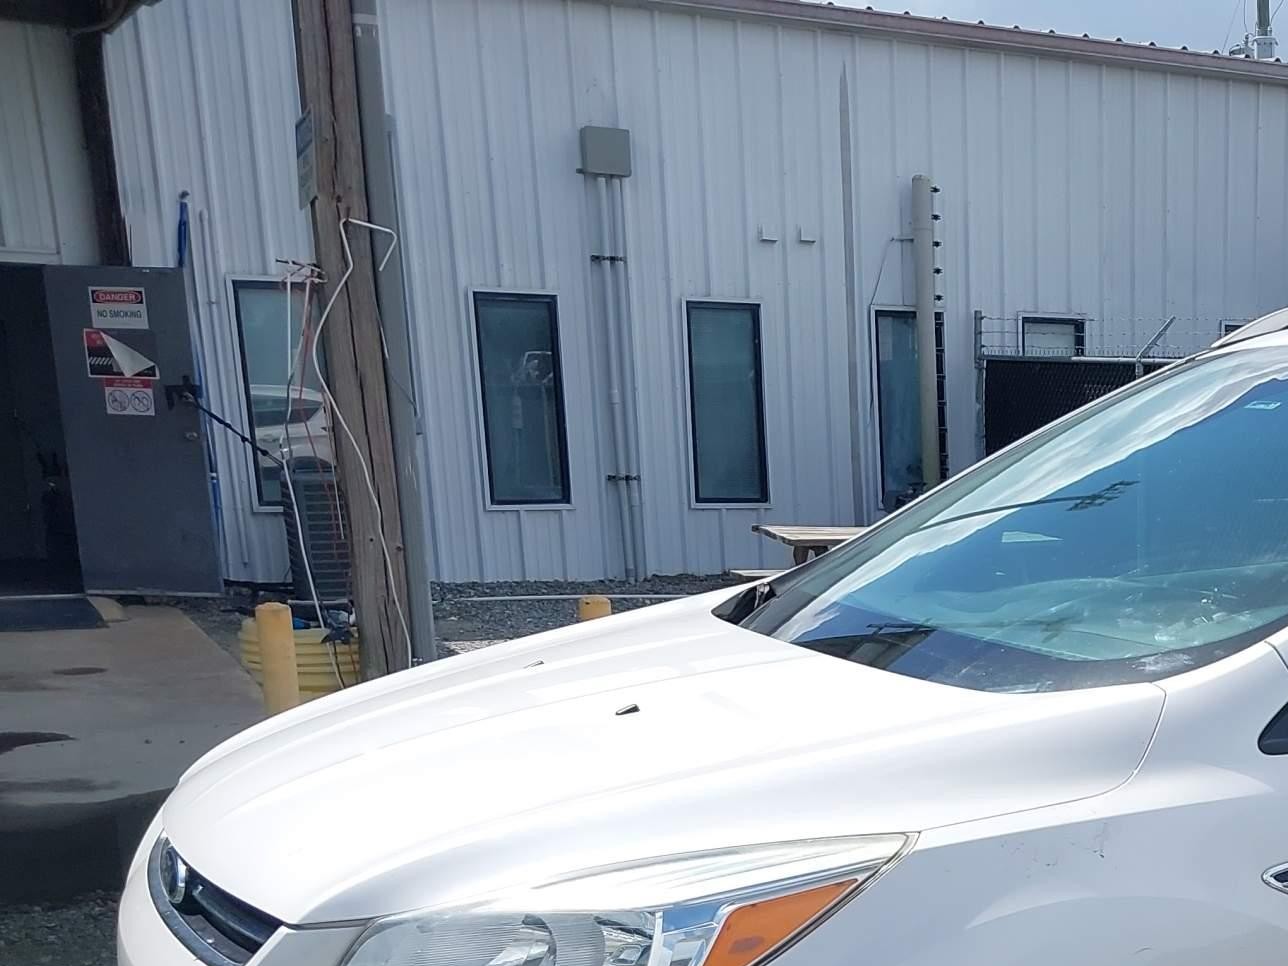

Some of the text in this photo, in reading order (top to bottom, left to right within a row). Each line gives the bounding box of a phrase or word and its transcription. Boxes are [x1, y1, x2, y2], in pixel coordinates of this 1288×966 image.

[98, 293, 136, 301] DANGER
[97, 309, 142, 319] NO SMOKING
